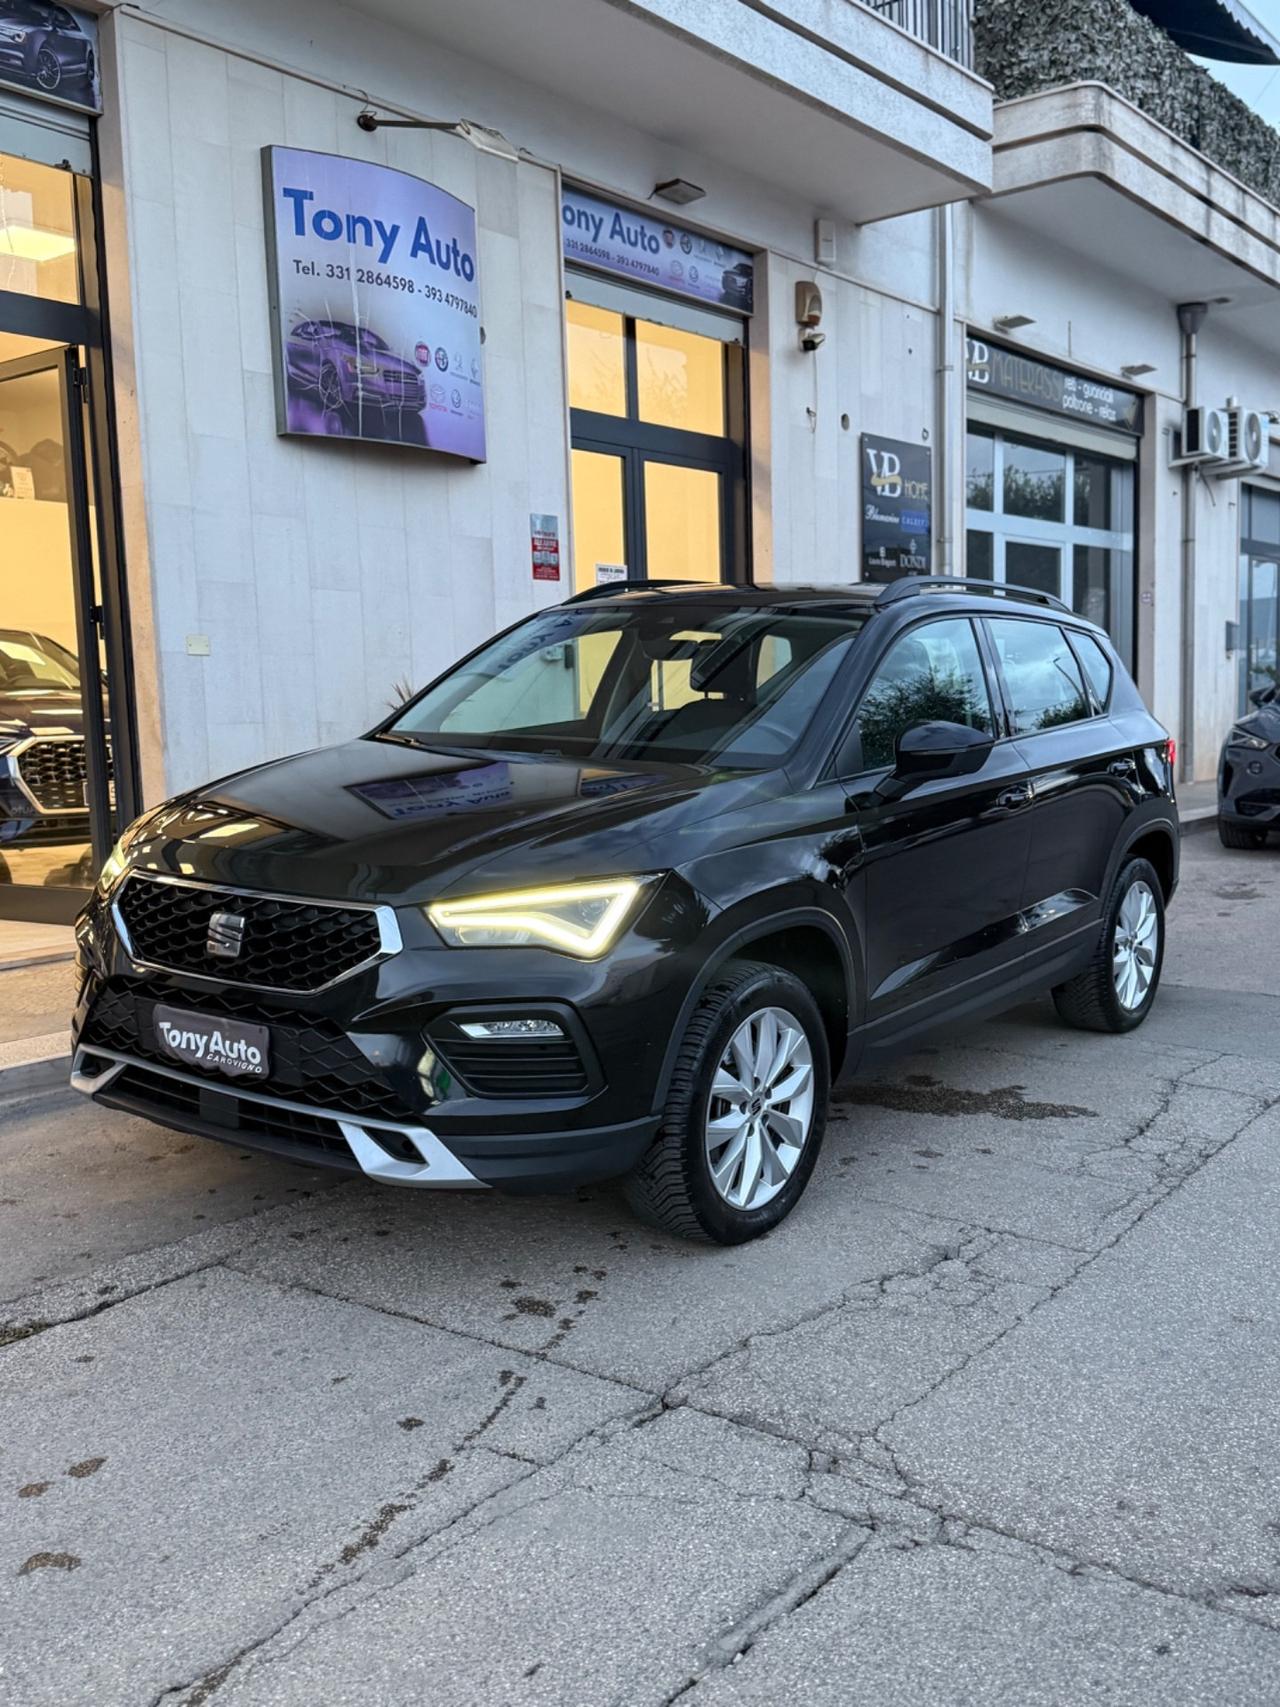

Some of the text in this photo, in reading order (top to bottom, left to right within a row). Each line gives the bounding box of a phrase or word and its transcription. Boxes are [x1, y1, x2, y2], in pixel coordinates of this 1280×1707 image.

[283, 187, 475, 282] Tony Auto
[562, 203, 661, 254] ony Auto
[293, 259, 321, 277] Tel.
[326, 264, 351, 281] 331
[356, 269, 415, 294] 2864598
[424, 285, 443, 303] 393
[444, 293, 478, 319] 4797840
[158, 1021, 261, 1065] Tony Auto
[206, 1053, 263, 1074] CAROVIGNO
